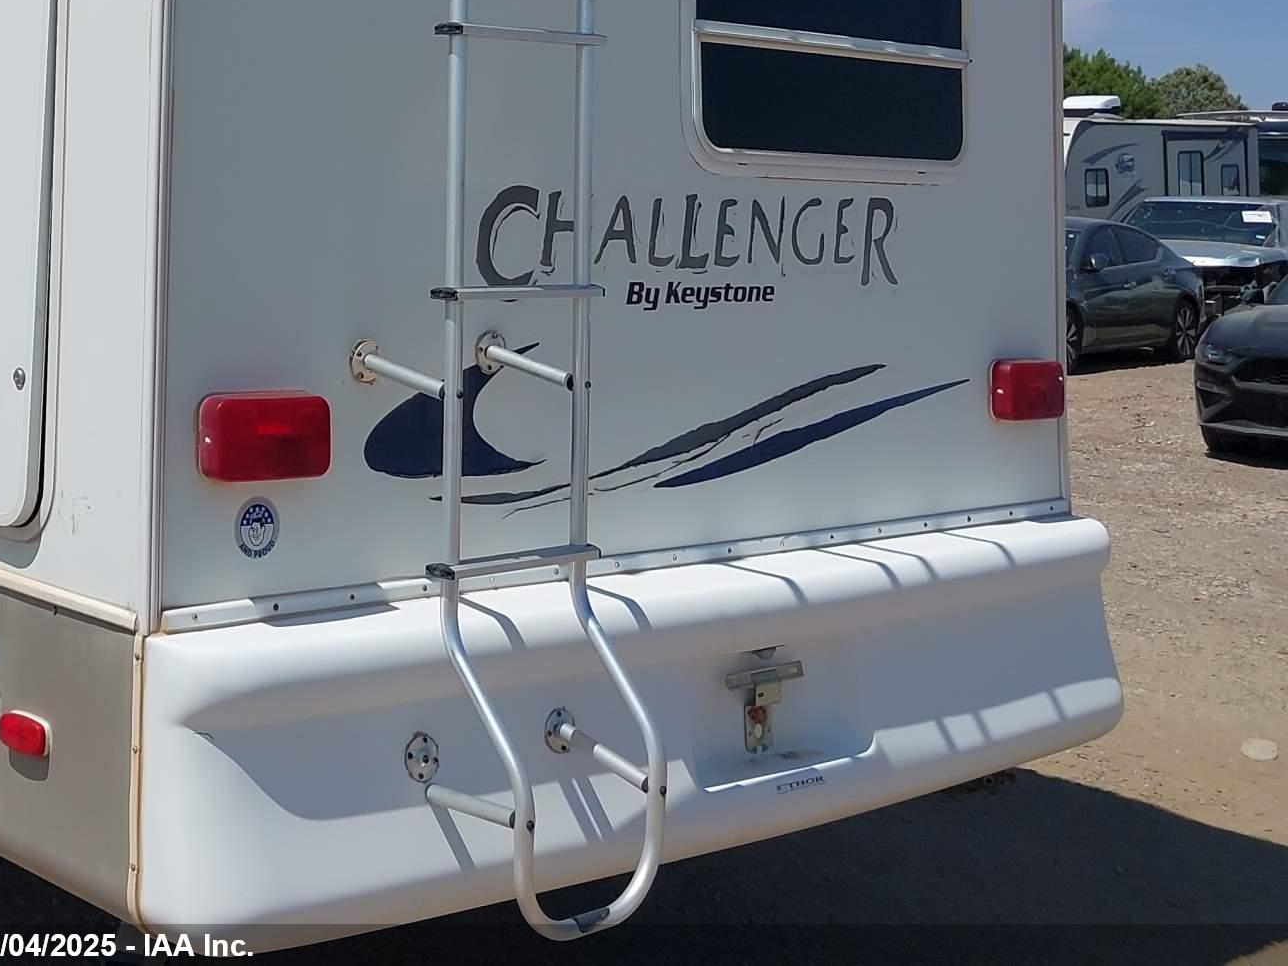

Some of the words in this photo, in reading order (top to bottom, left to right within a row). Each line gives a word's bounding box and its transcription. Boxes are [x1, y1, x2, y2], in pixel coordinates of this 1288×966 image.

[476, 185, 898, 301] CHALLENGER
[626, 282, 660, 310] By
[665, 281, 774, 309] Keystone
[253, 540, 275, 559] PROUD
